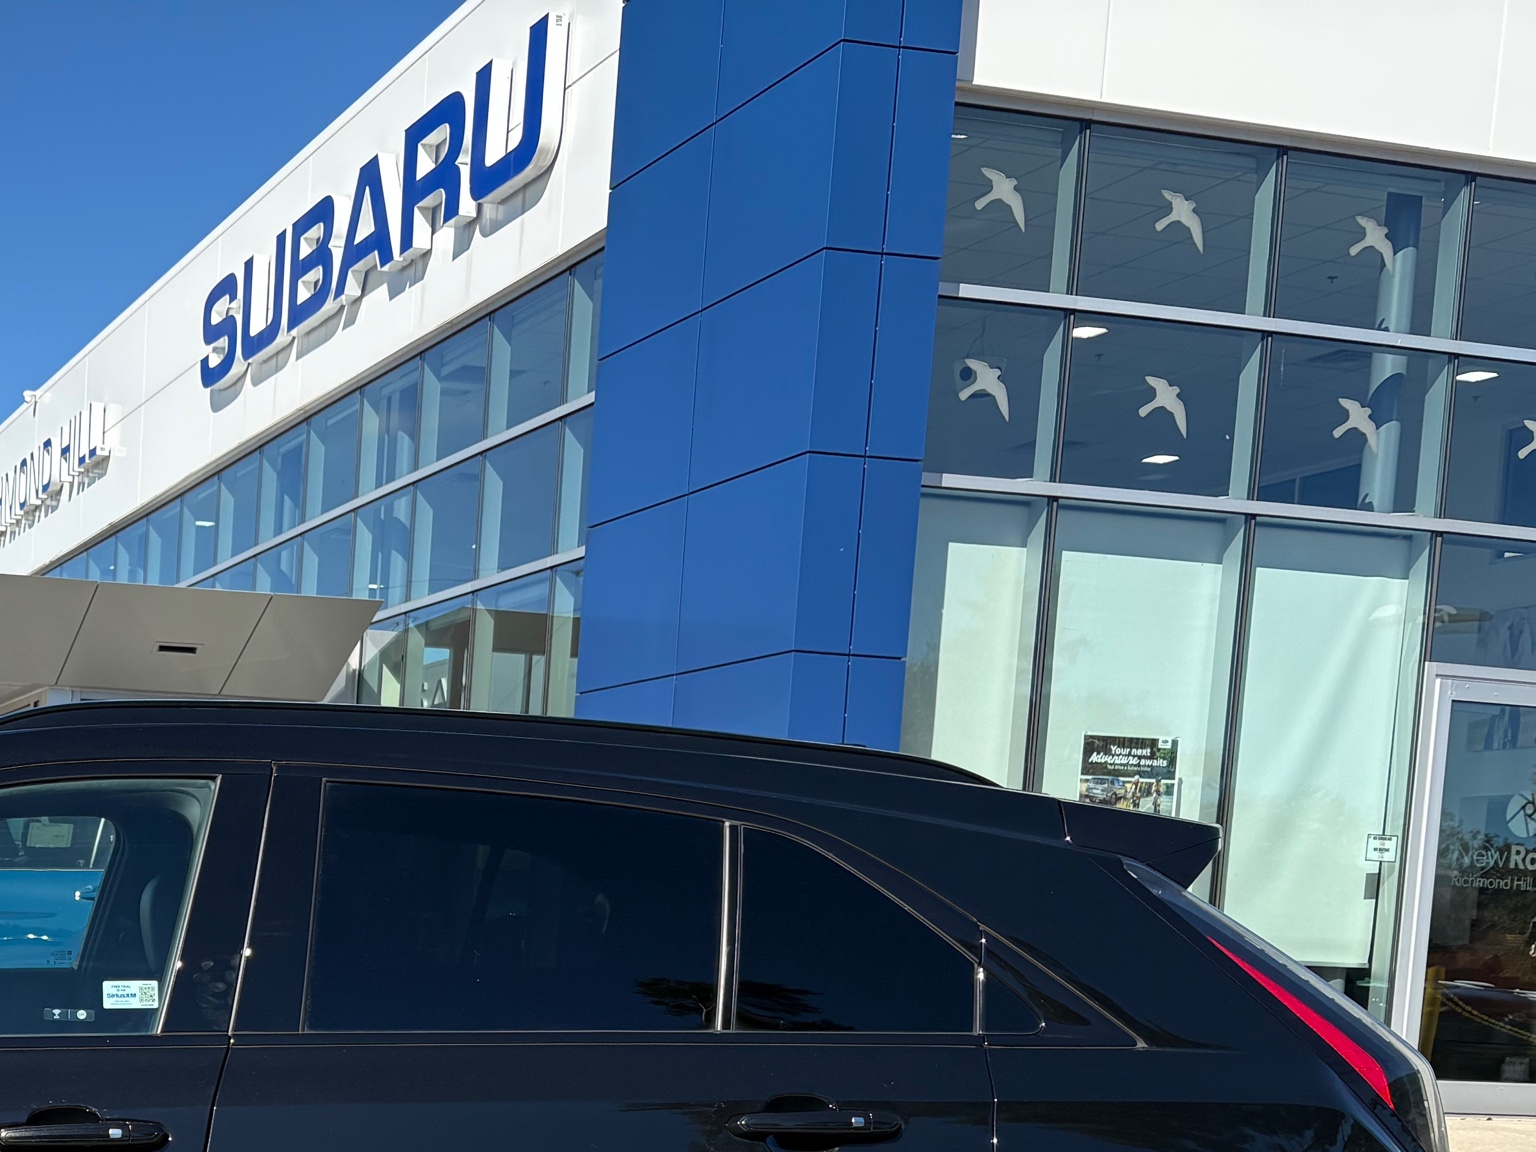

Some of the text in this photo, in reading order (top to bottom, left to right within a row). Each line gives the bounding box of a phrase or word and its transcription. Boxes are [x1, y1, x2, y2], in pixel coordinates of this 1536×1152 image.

[200, 12, 550, 389] SUBARU
[60, 402, 104, 483] HILL
[1088, 752, 1168, 767] Adventure awaits
[1110, 745, 1151, 756] Your next
[1451, 870, 1533, 891] Richmond Hill
